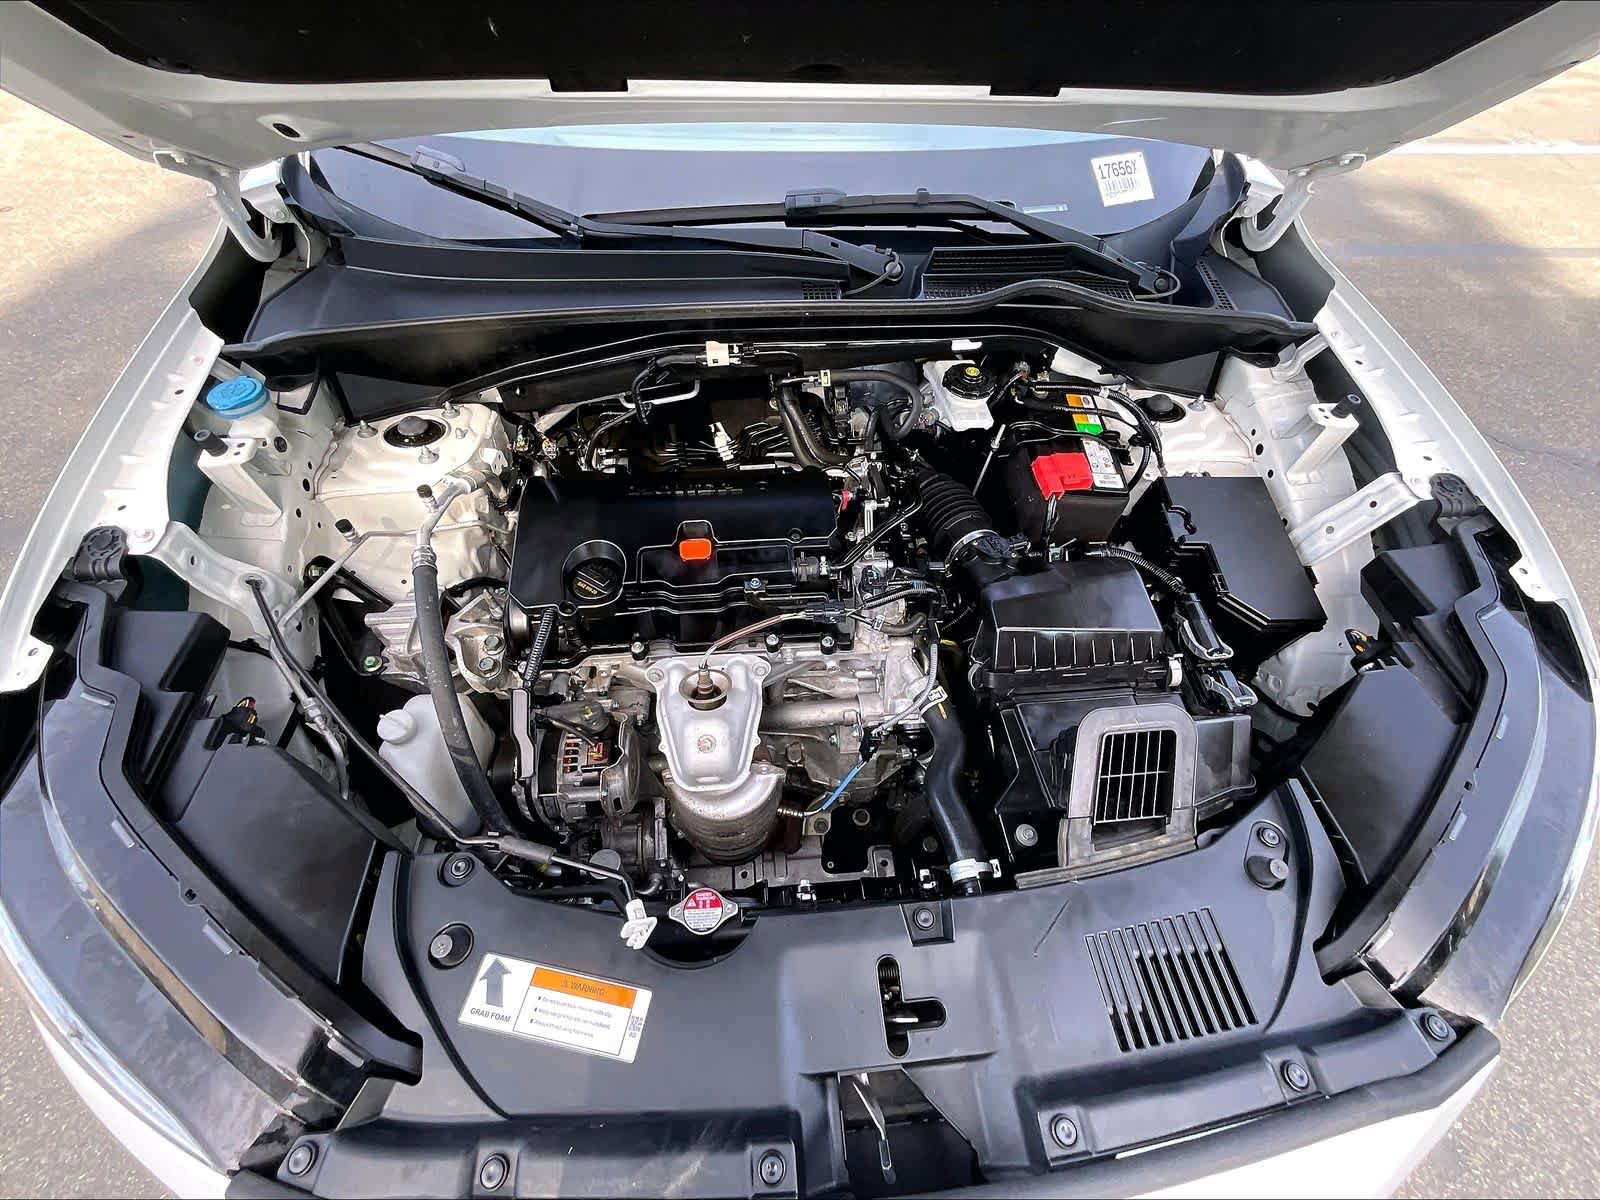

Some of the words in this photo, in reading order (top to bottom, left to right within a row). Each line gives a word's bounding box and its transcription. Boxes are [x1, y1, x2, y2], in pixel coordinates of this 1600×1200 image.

[570, 982, 606, 997] WARNING
[470, 1007, 490, 1019] GRAB
[490, 1010, 512, 1023] FOAM
